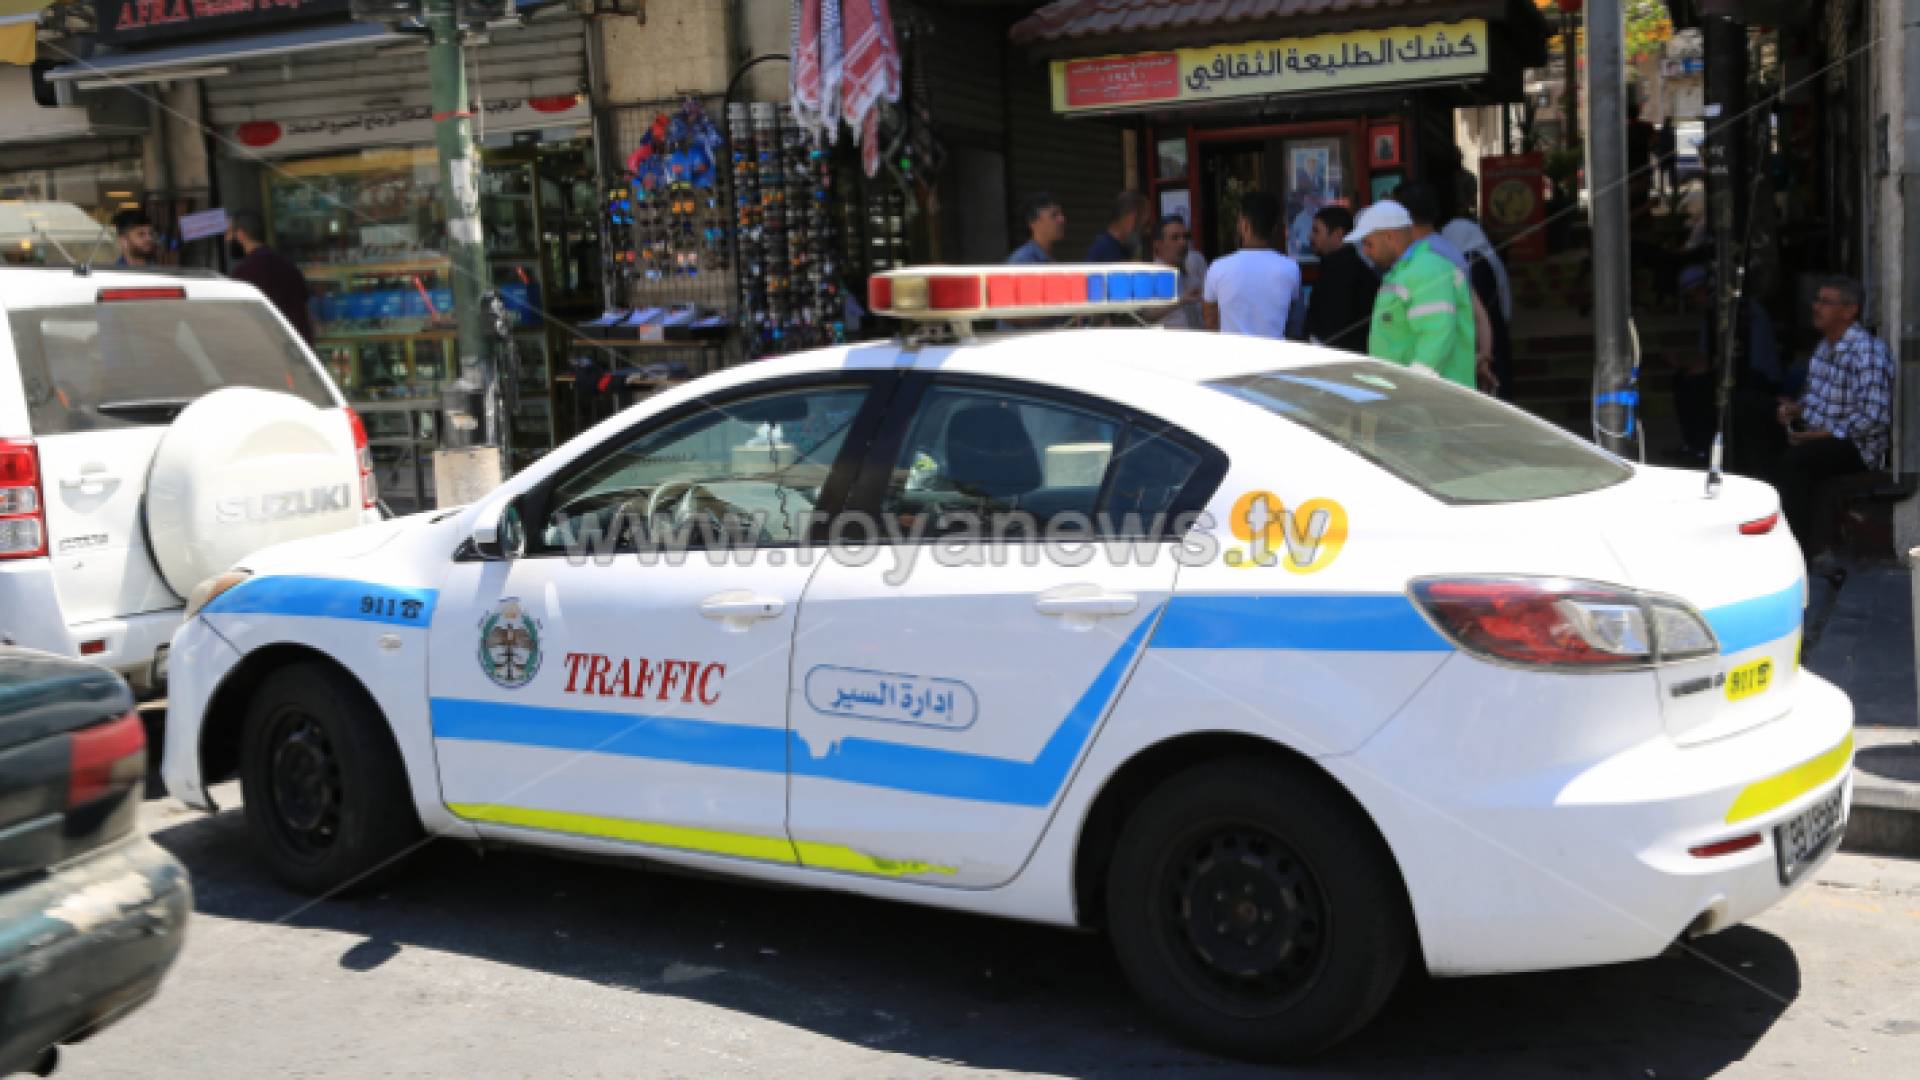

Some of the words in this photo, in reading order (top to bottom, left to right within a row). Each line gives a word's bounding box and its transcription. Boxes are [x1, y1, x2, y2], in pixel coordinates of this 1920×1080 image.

[1284, 38, 1393, 76] الطليعة
[1397, 32, 1477, 61] كشك
[1185, 49, 1281, 91] الثقافي
[215, 482, 352, 525] SUZUKI
[361, 596, 397, 617] 911
[563, 651, 727, 705] TRAFFIC
[831, 680, 897, 710] السير
[902, 682, 954, 721] إدارة
